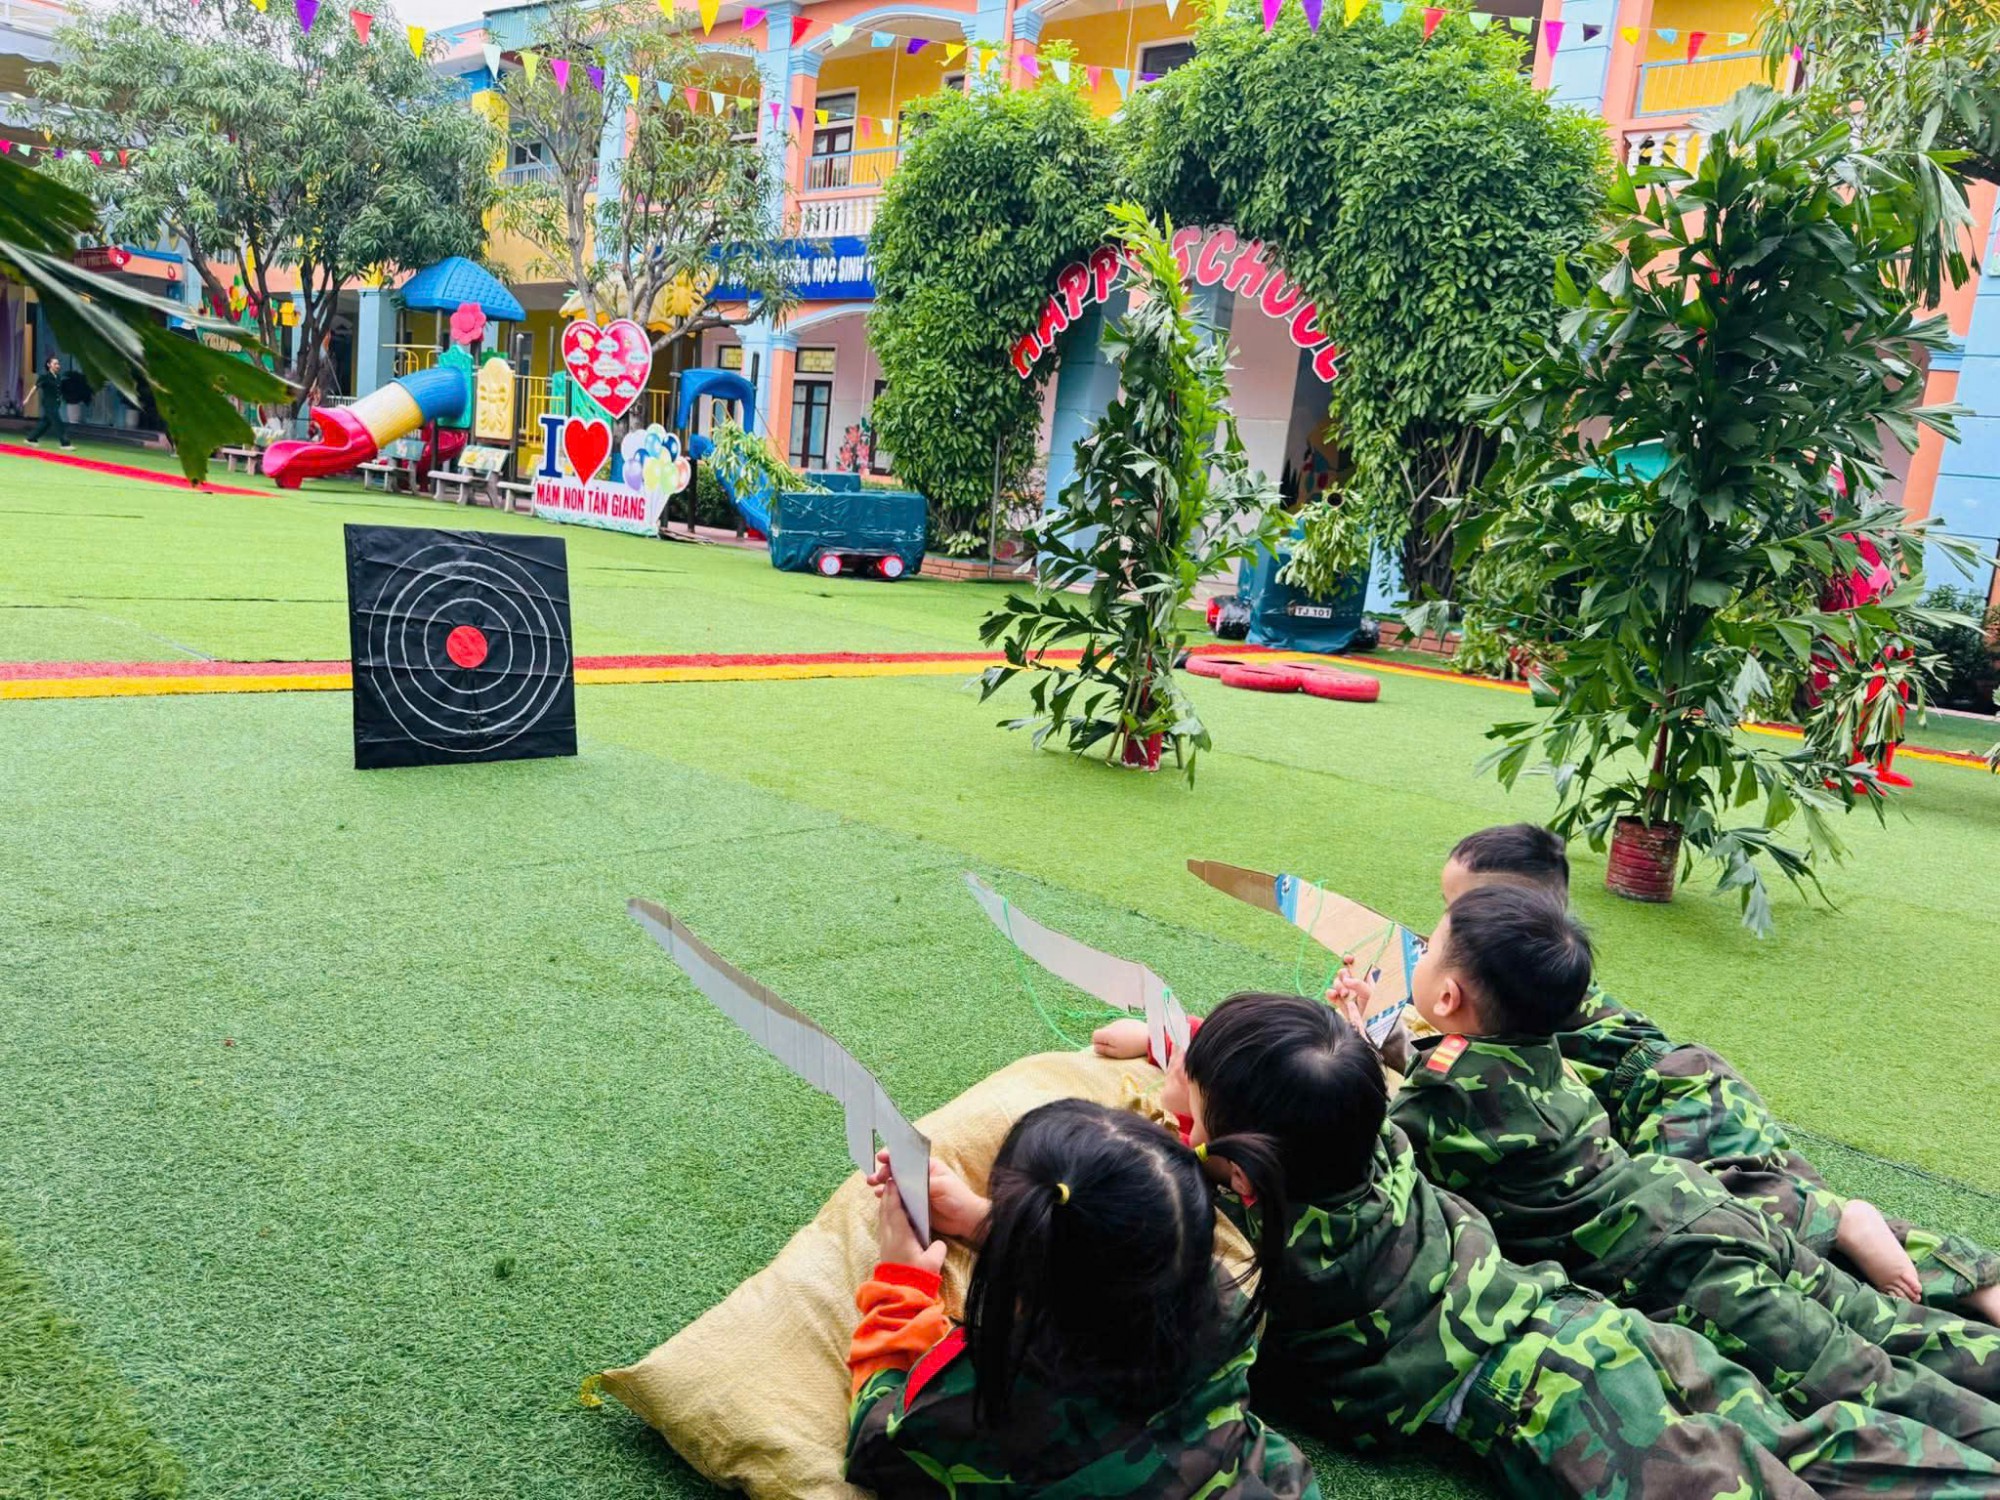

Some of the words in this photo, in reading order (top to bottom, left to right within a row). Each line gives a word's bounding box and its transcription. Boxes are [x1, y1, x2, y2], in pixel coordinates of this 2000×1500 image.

[813, 256, 837, 288] HỌC
[838, 255, 865, 283] SINH
[539, 417, 564, 478] I
[564, 487, 584, 512] NON
[611, 493, 646, 521] GIANG
[1297, 607, 1310, 616] TJ
[1313, 608, 1330, 617] 101
